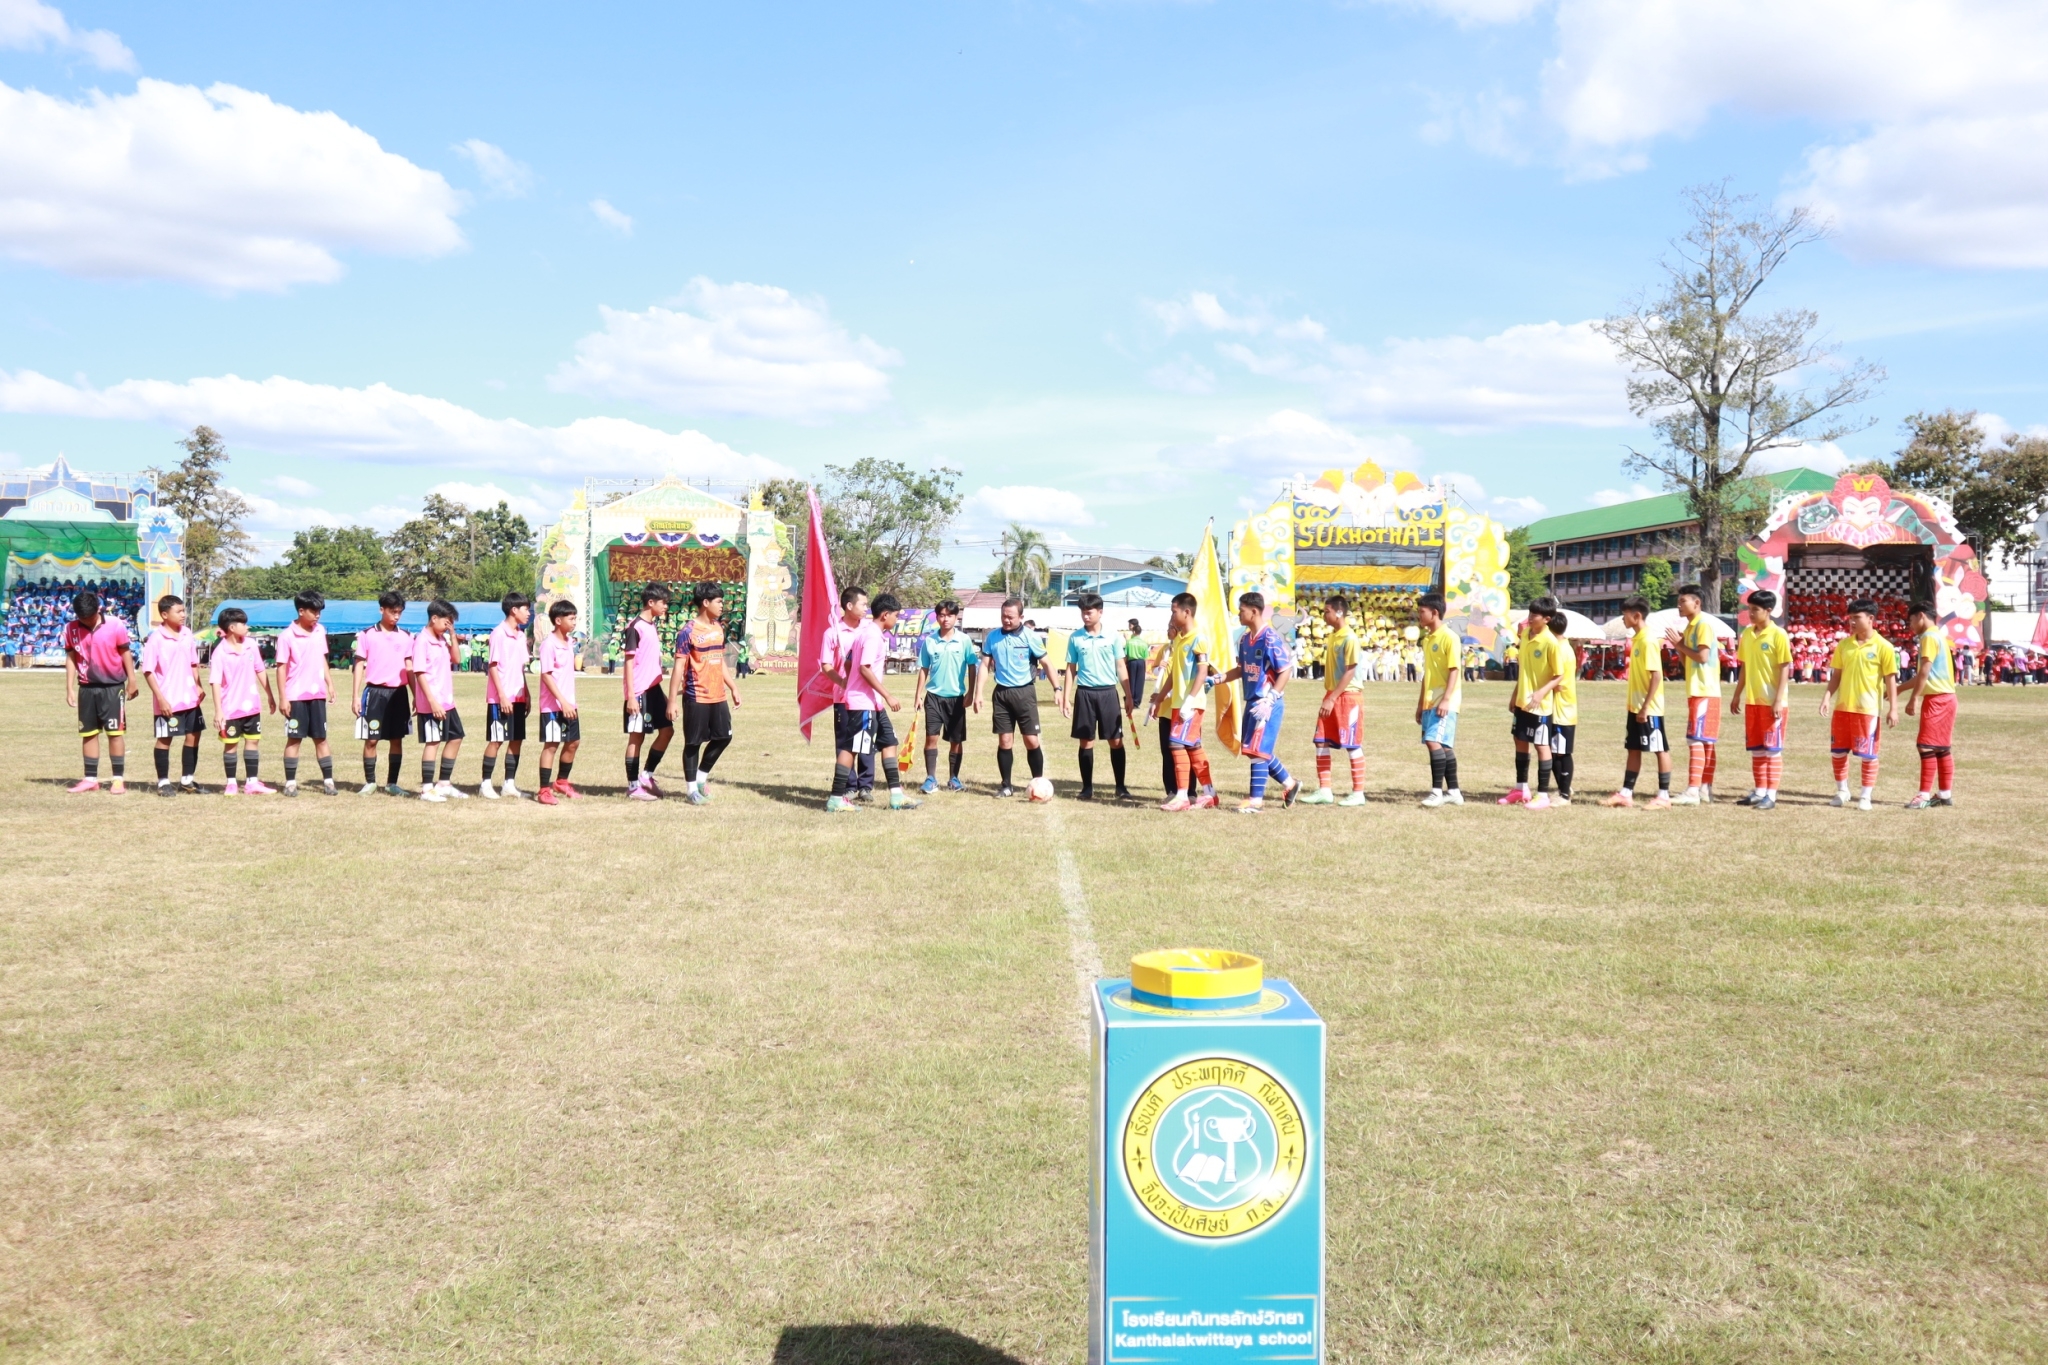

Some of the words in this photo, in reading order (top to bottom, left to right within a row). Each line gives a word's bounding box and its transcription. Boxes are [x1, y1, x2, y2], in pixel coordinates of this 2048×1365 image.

[1298, 522, 1444, 548] SUKHOTHAI
[108, 718, 118, 729] 21
[1640, 735, 1649, 746] 13
[1129, 1089, 1164, 1137] เรียนดี
[1171, 1063, 1250, 1090] ประพฤติดี
[1258, 1081, 1300, 1136] กีฬาเด่น
[1141, 1180, 1229, 1233] จึงจะเป็นศิษย์
[1121, 1308, 1305, 1328] โรงเรียนกันทรลักษ์วิทยา
[1115, 1333, 1254, 1349] Kanthalakwittaya
[1258, 1331, 1312, 1346] school
